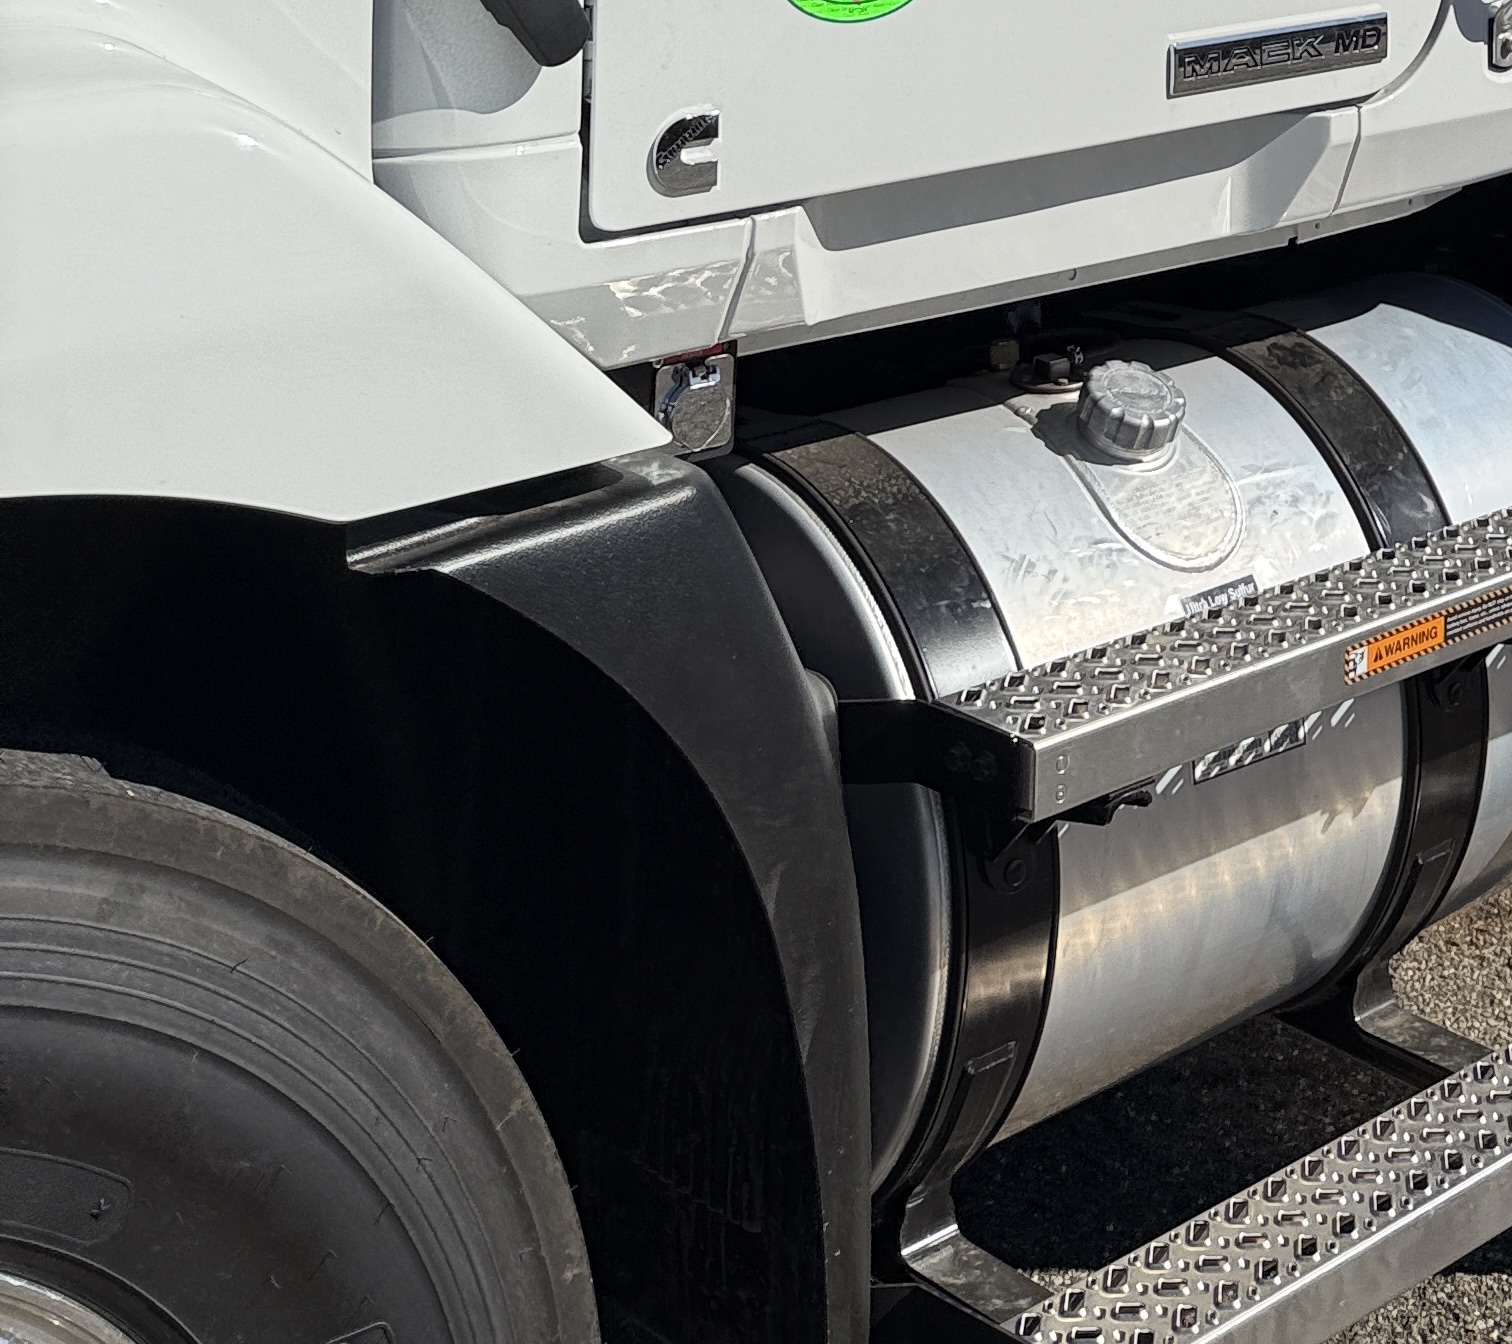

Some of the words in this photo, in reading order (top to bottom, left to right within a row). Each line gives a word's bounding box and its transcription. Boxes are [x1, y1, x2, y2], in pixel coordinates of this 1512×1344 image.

[1334, 25, 1382, 56] MD
[1207, 592, 1229, 608] Low
[1384, 625, 1439, 658] WARNING
